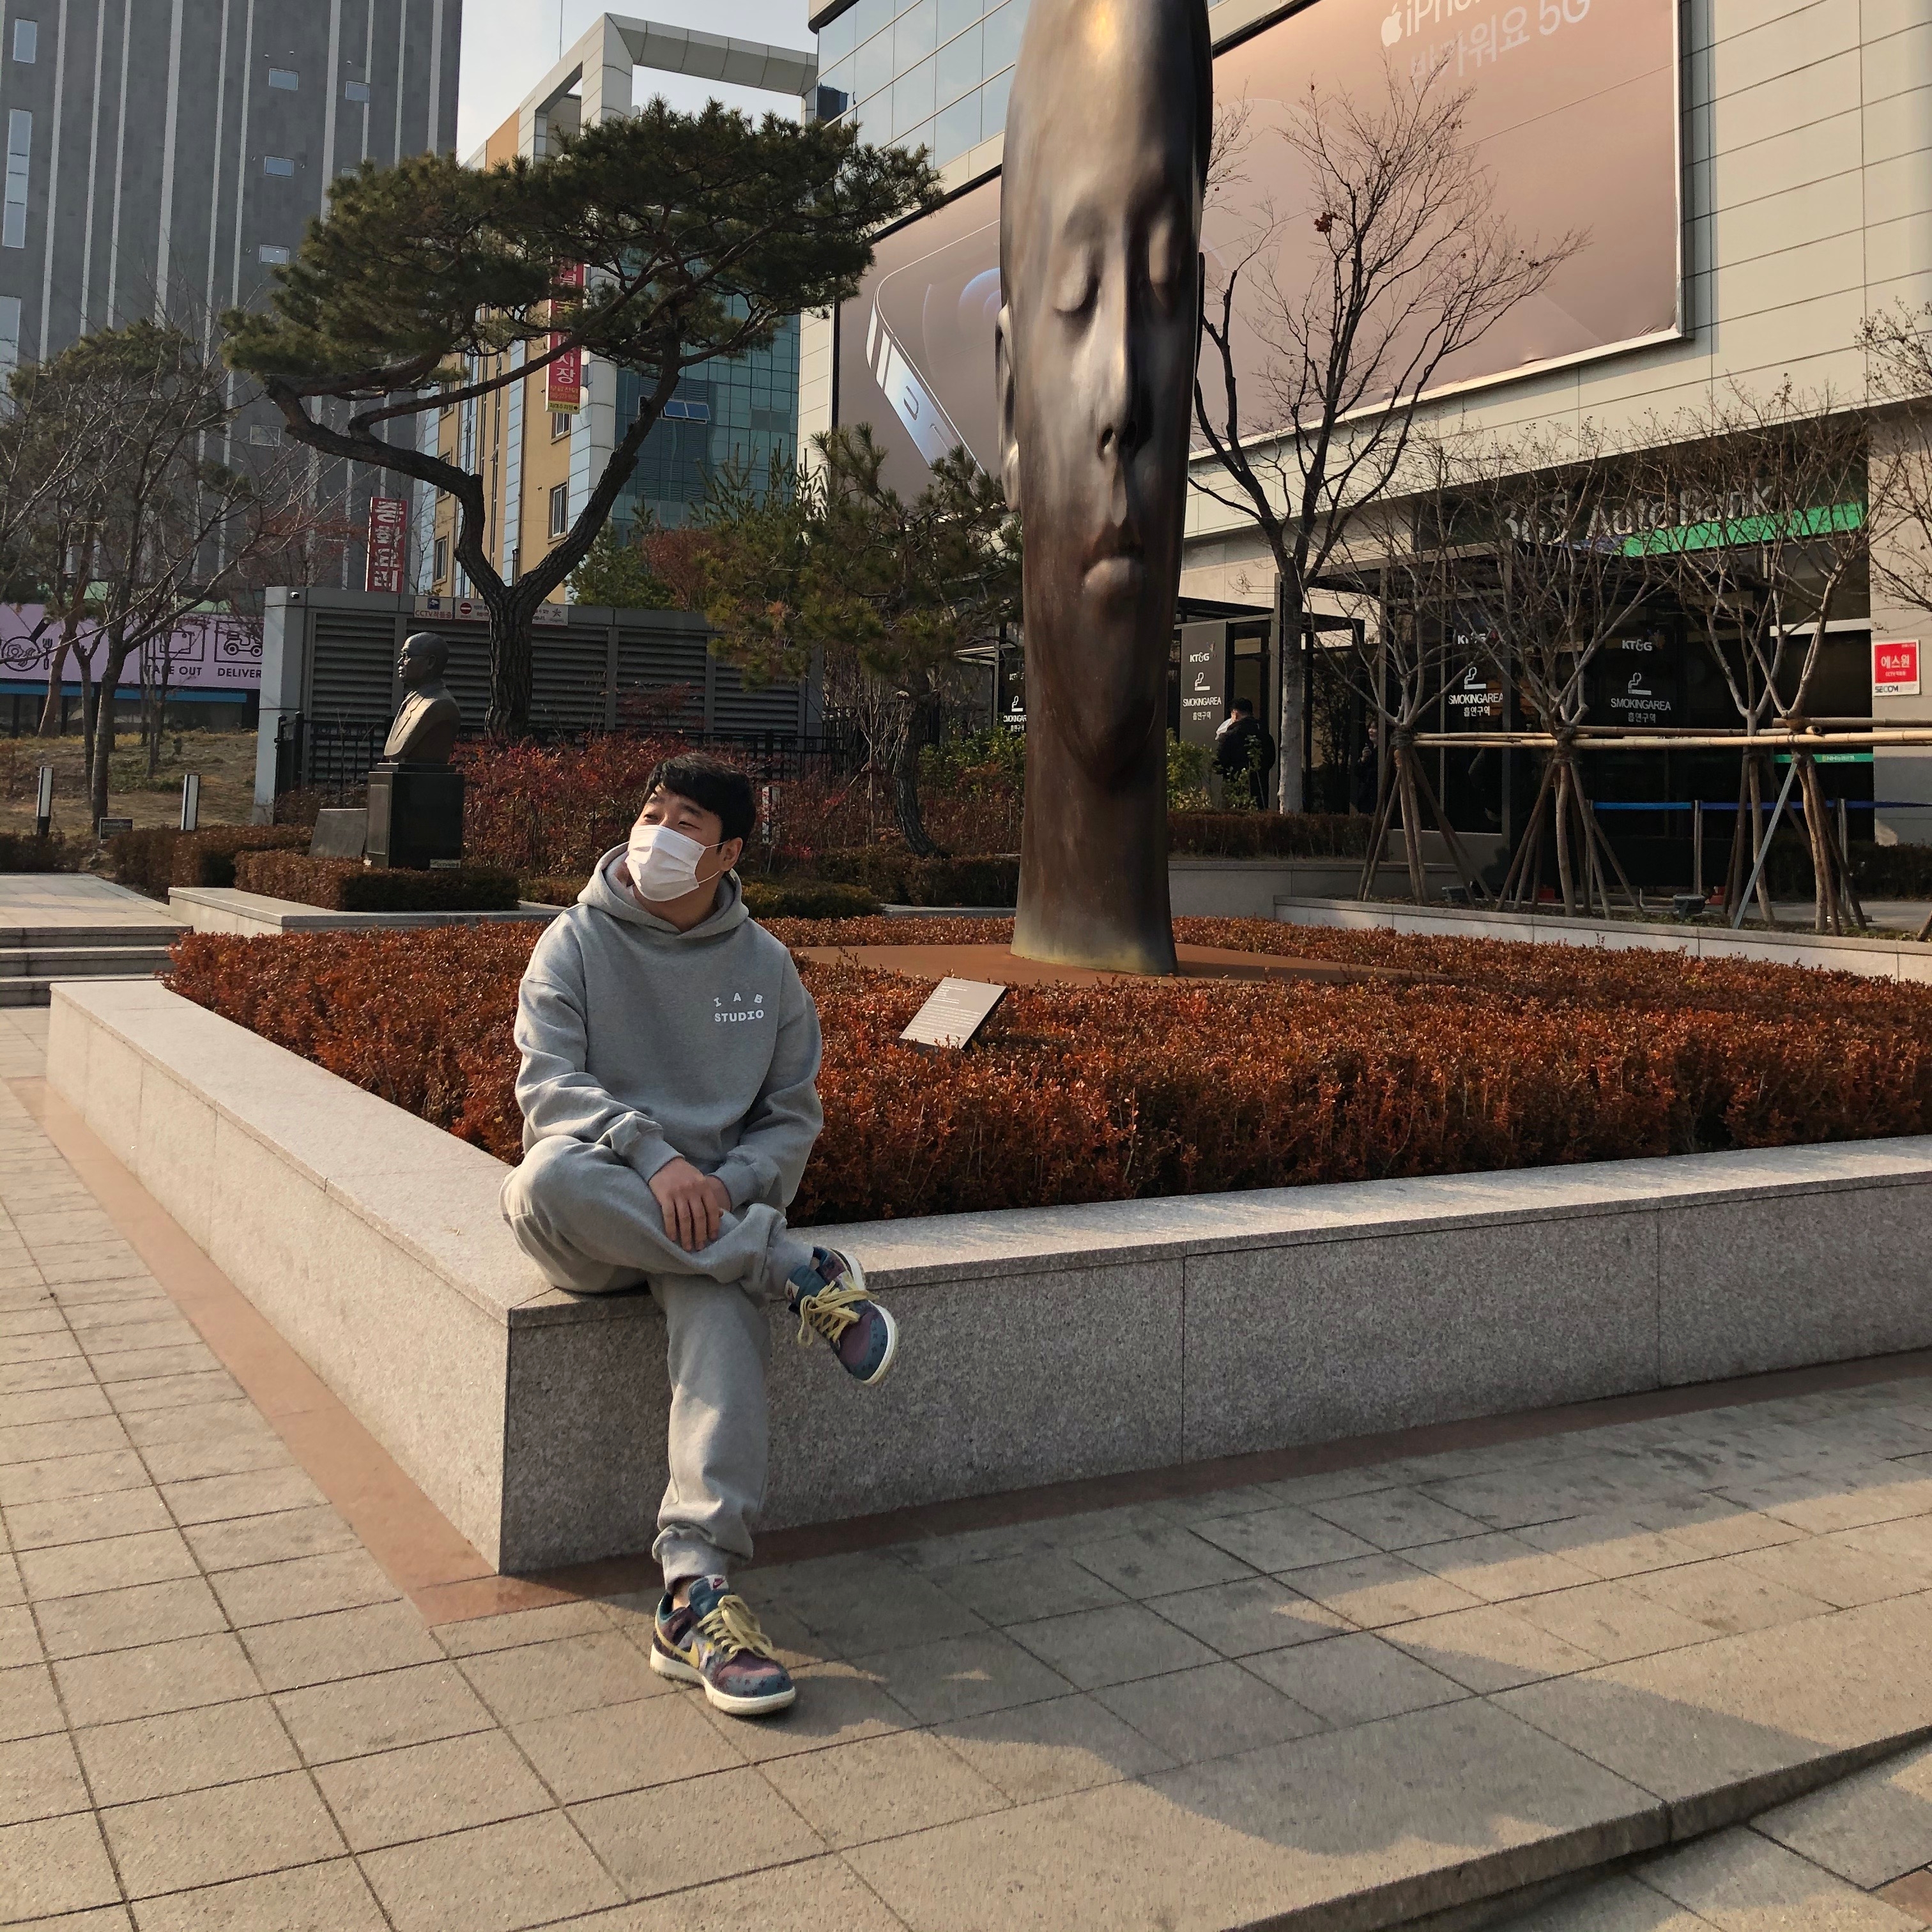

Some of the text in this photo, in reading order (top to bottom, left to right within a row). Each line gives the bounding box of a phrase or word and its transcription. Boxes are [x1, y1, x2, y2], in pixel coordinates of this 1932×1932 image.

[1409, 0, 1590, 95] 반가워요 5G
[1621, 639, 1653, 652] KT&G
[1190, 652, 1210, 663] KT&G
[1881, 654, 1910, 669] 에스원
[179, 666, 203, 676] OUT
[1874, 685, 1899, 693] SECOM
[1183, 696, 1222, 707] SMOKINGAREA
[1448, 693, 1503, 705] SMOKINGAREA
[1611, 698, 1671, 711] SMOKINGAREA
[1192, 711, 1211, 721] 흡연구역
[1464, 705, 1491, 717] 흡연구역
[1627, 712, 1656, 723] 흡연구역
[714, 1009, 764, 1022] STUDIO
